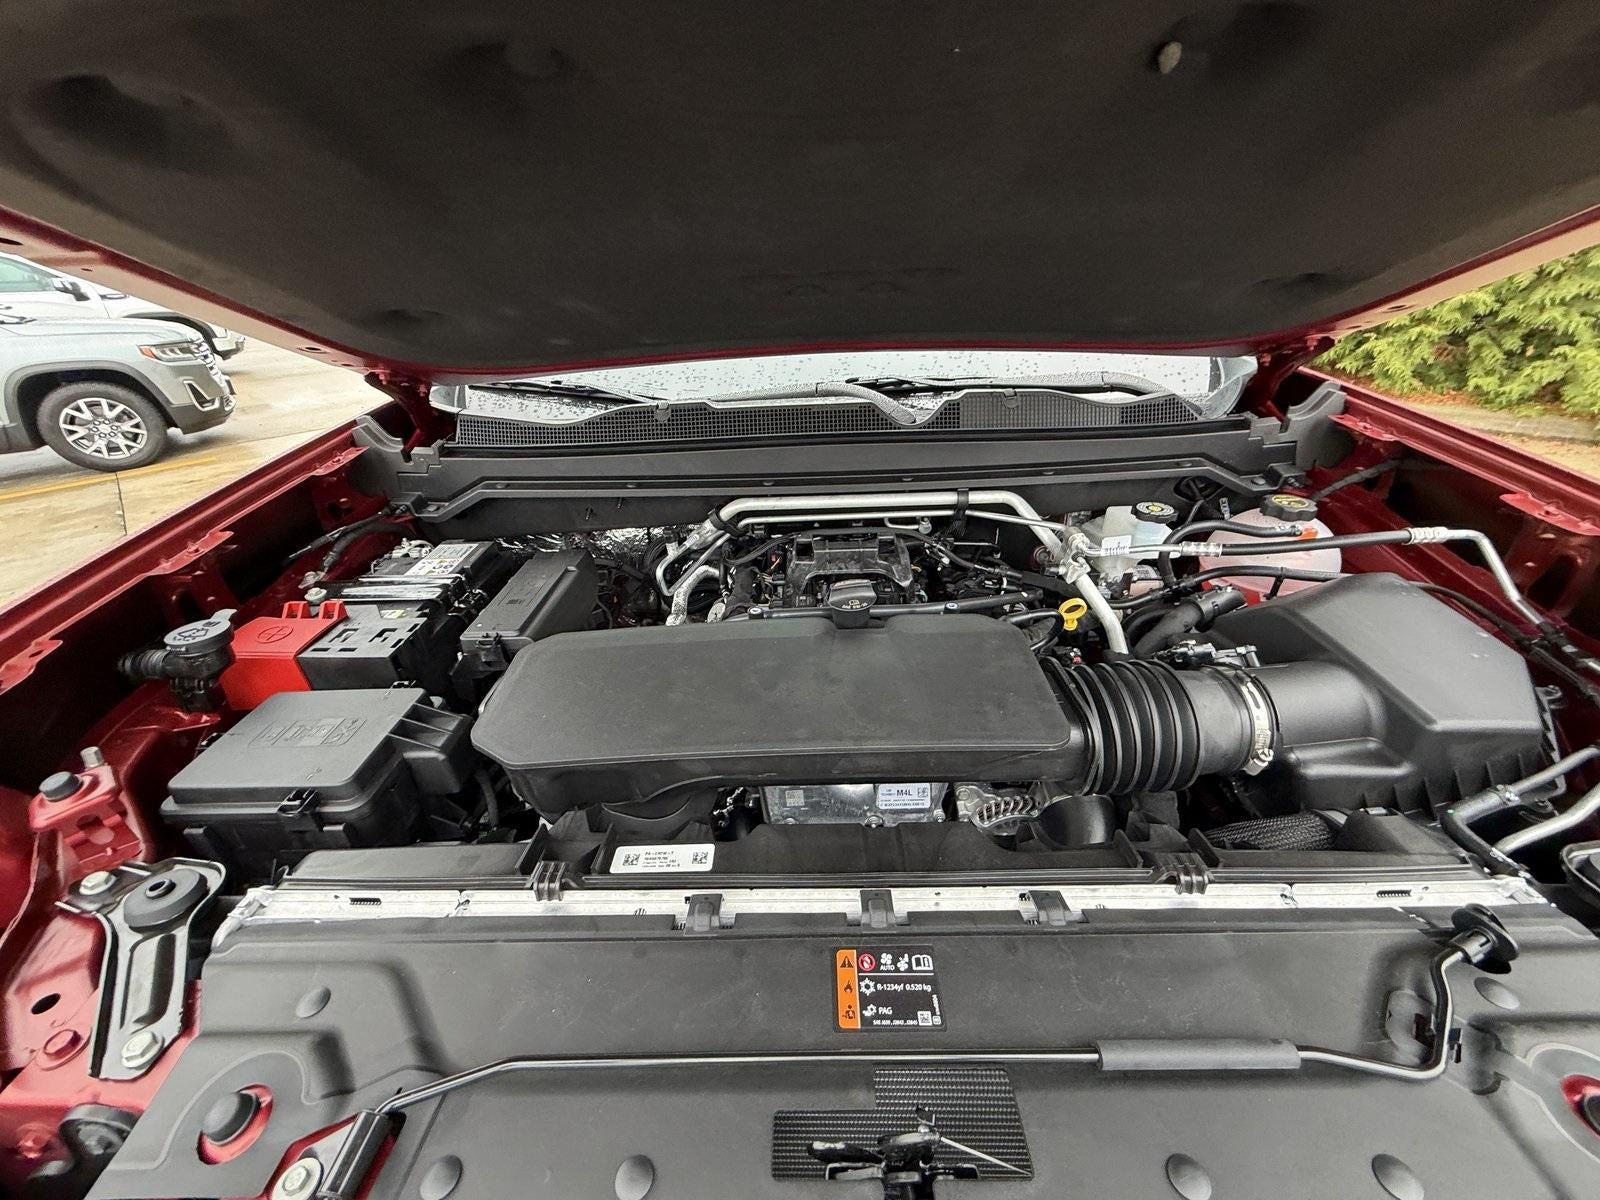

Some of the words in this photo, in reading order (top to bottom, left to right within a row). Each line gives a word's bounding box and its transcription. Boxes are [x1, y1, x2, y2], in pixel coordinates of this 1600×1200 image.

[876, 983, 904, 992] R-1234yf
[905, 983, 923, 991] 0.520
[923, 983, 932, 992] kg
[878, 1006, 893, 1014] PAG
